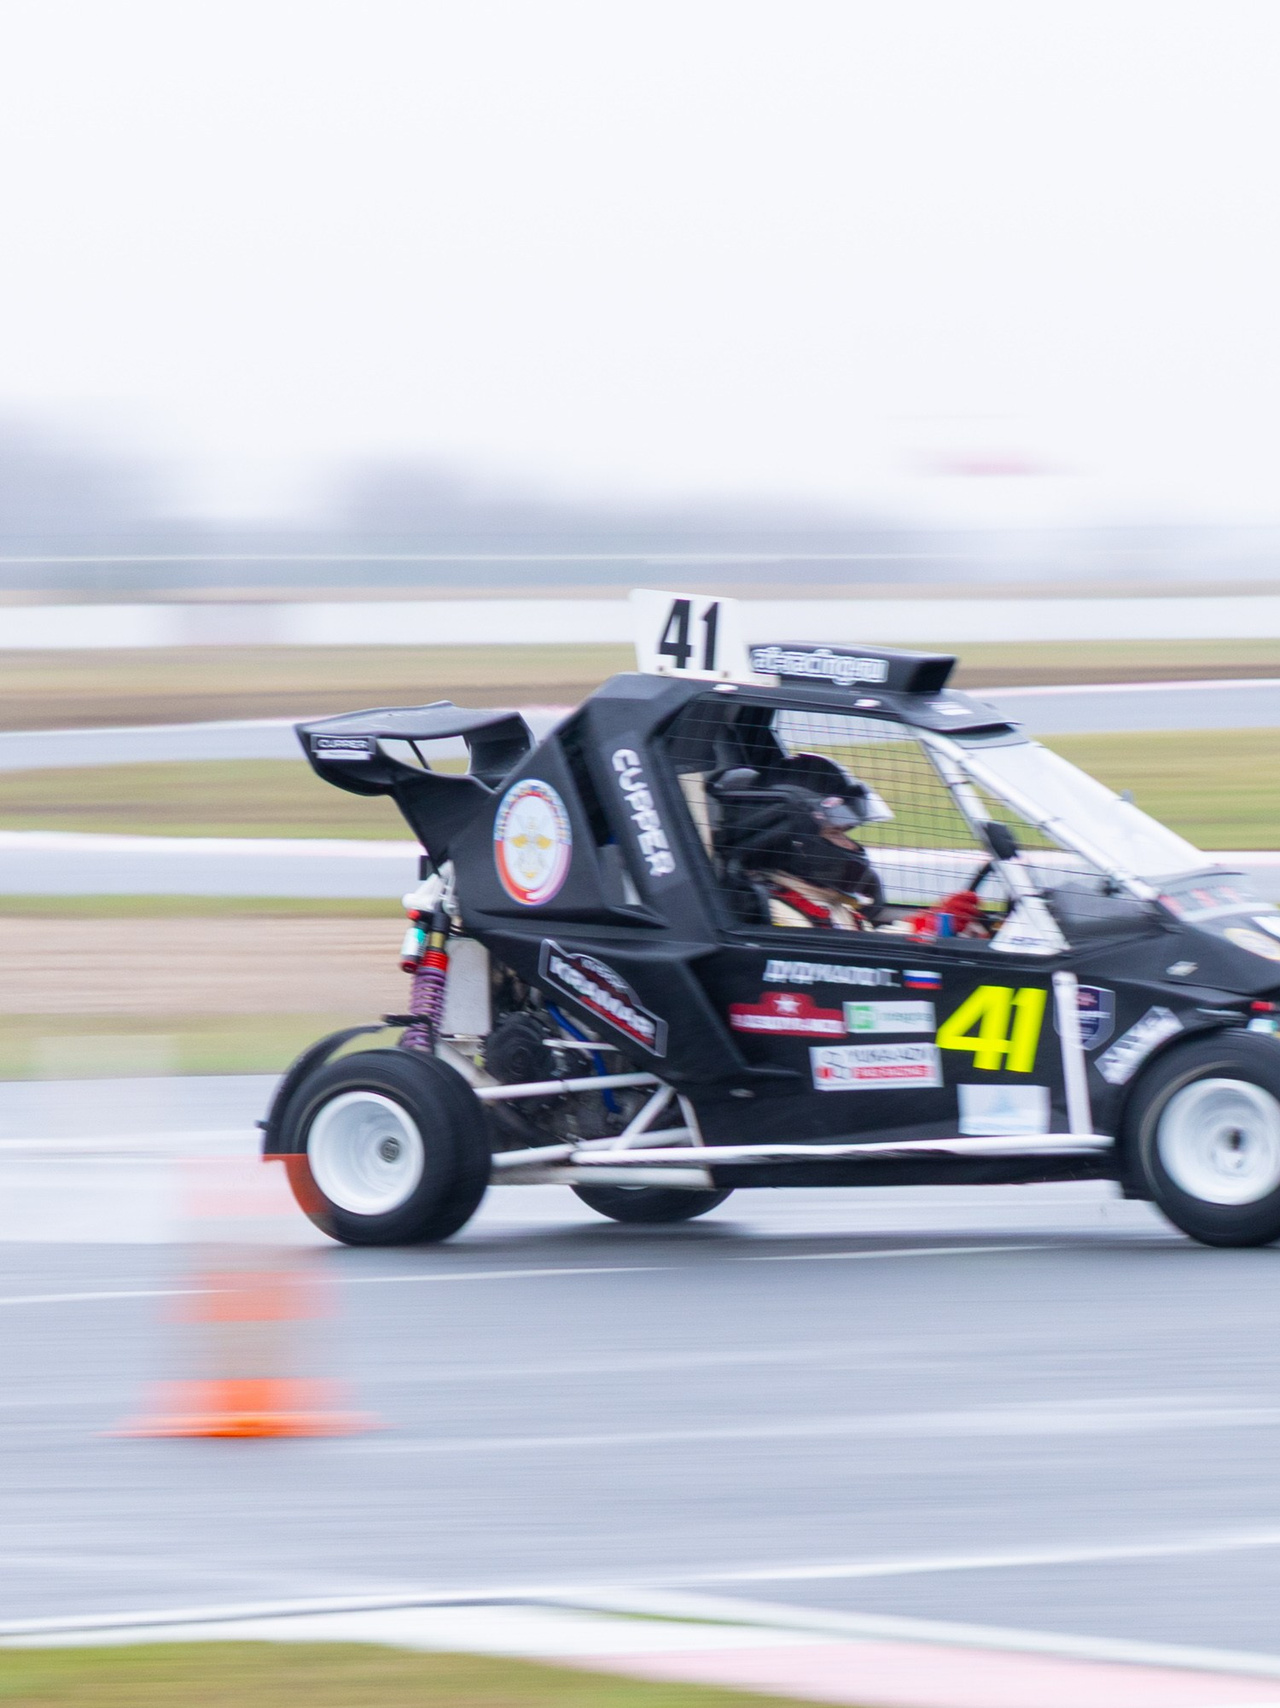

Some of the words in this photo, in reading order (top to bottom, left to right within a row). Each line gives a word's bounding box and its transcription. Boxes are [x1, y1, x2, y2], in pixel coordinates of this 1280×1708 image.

[658, 599, 719, 671] 41
[611, 748, 676, 877] CUPPER
[935, 985, 1047, 1072] 41
